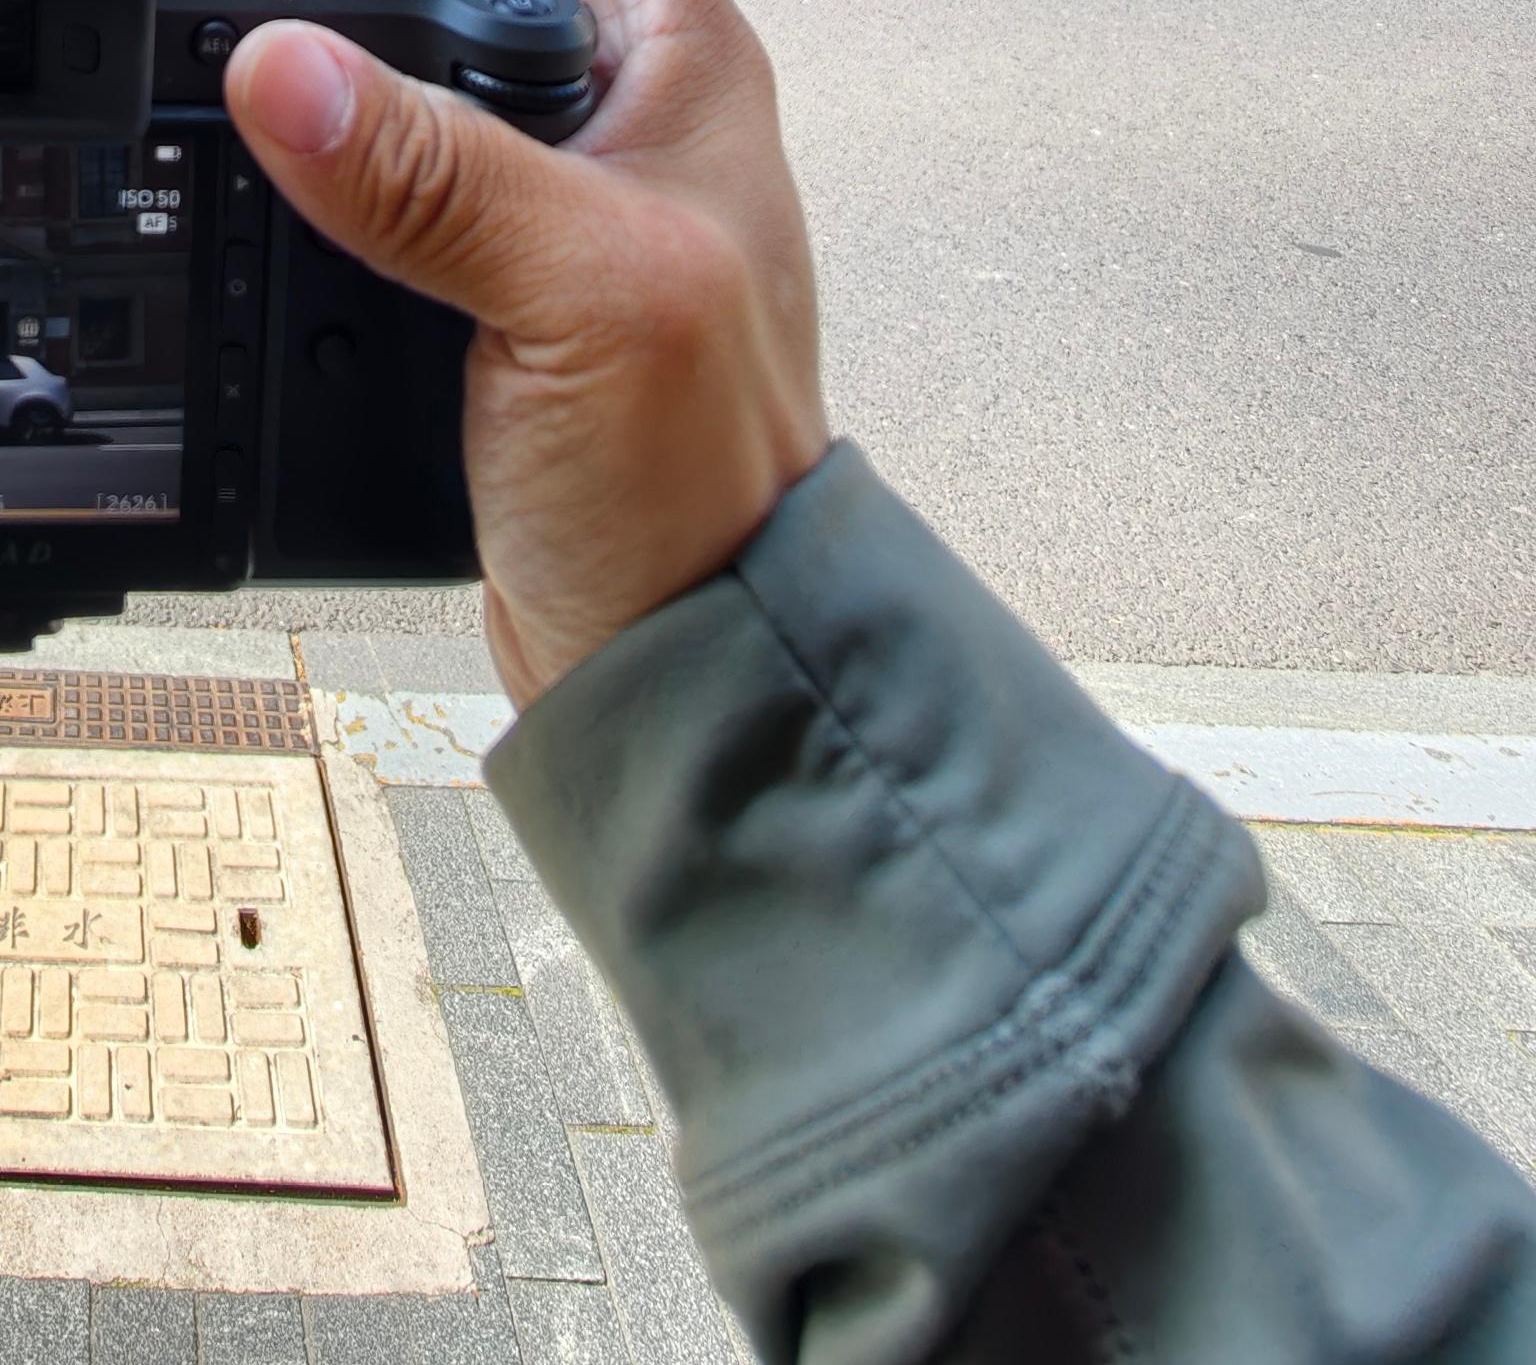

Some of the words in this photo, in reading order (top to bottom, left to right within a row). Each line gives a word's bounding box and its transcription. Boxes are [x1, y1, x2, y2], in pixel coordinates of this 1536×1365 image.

[118, 189, 154, 209] ISO
[155, 189, 181, 209] 50
[143, 215, 164, 230] AF
